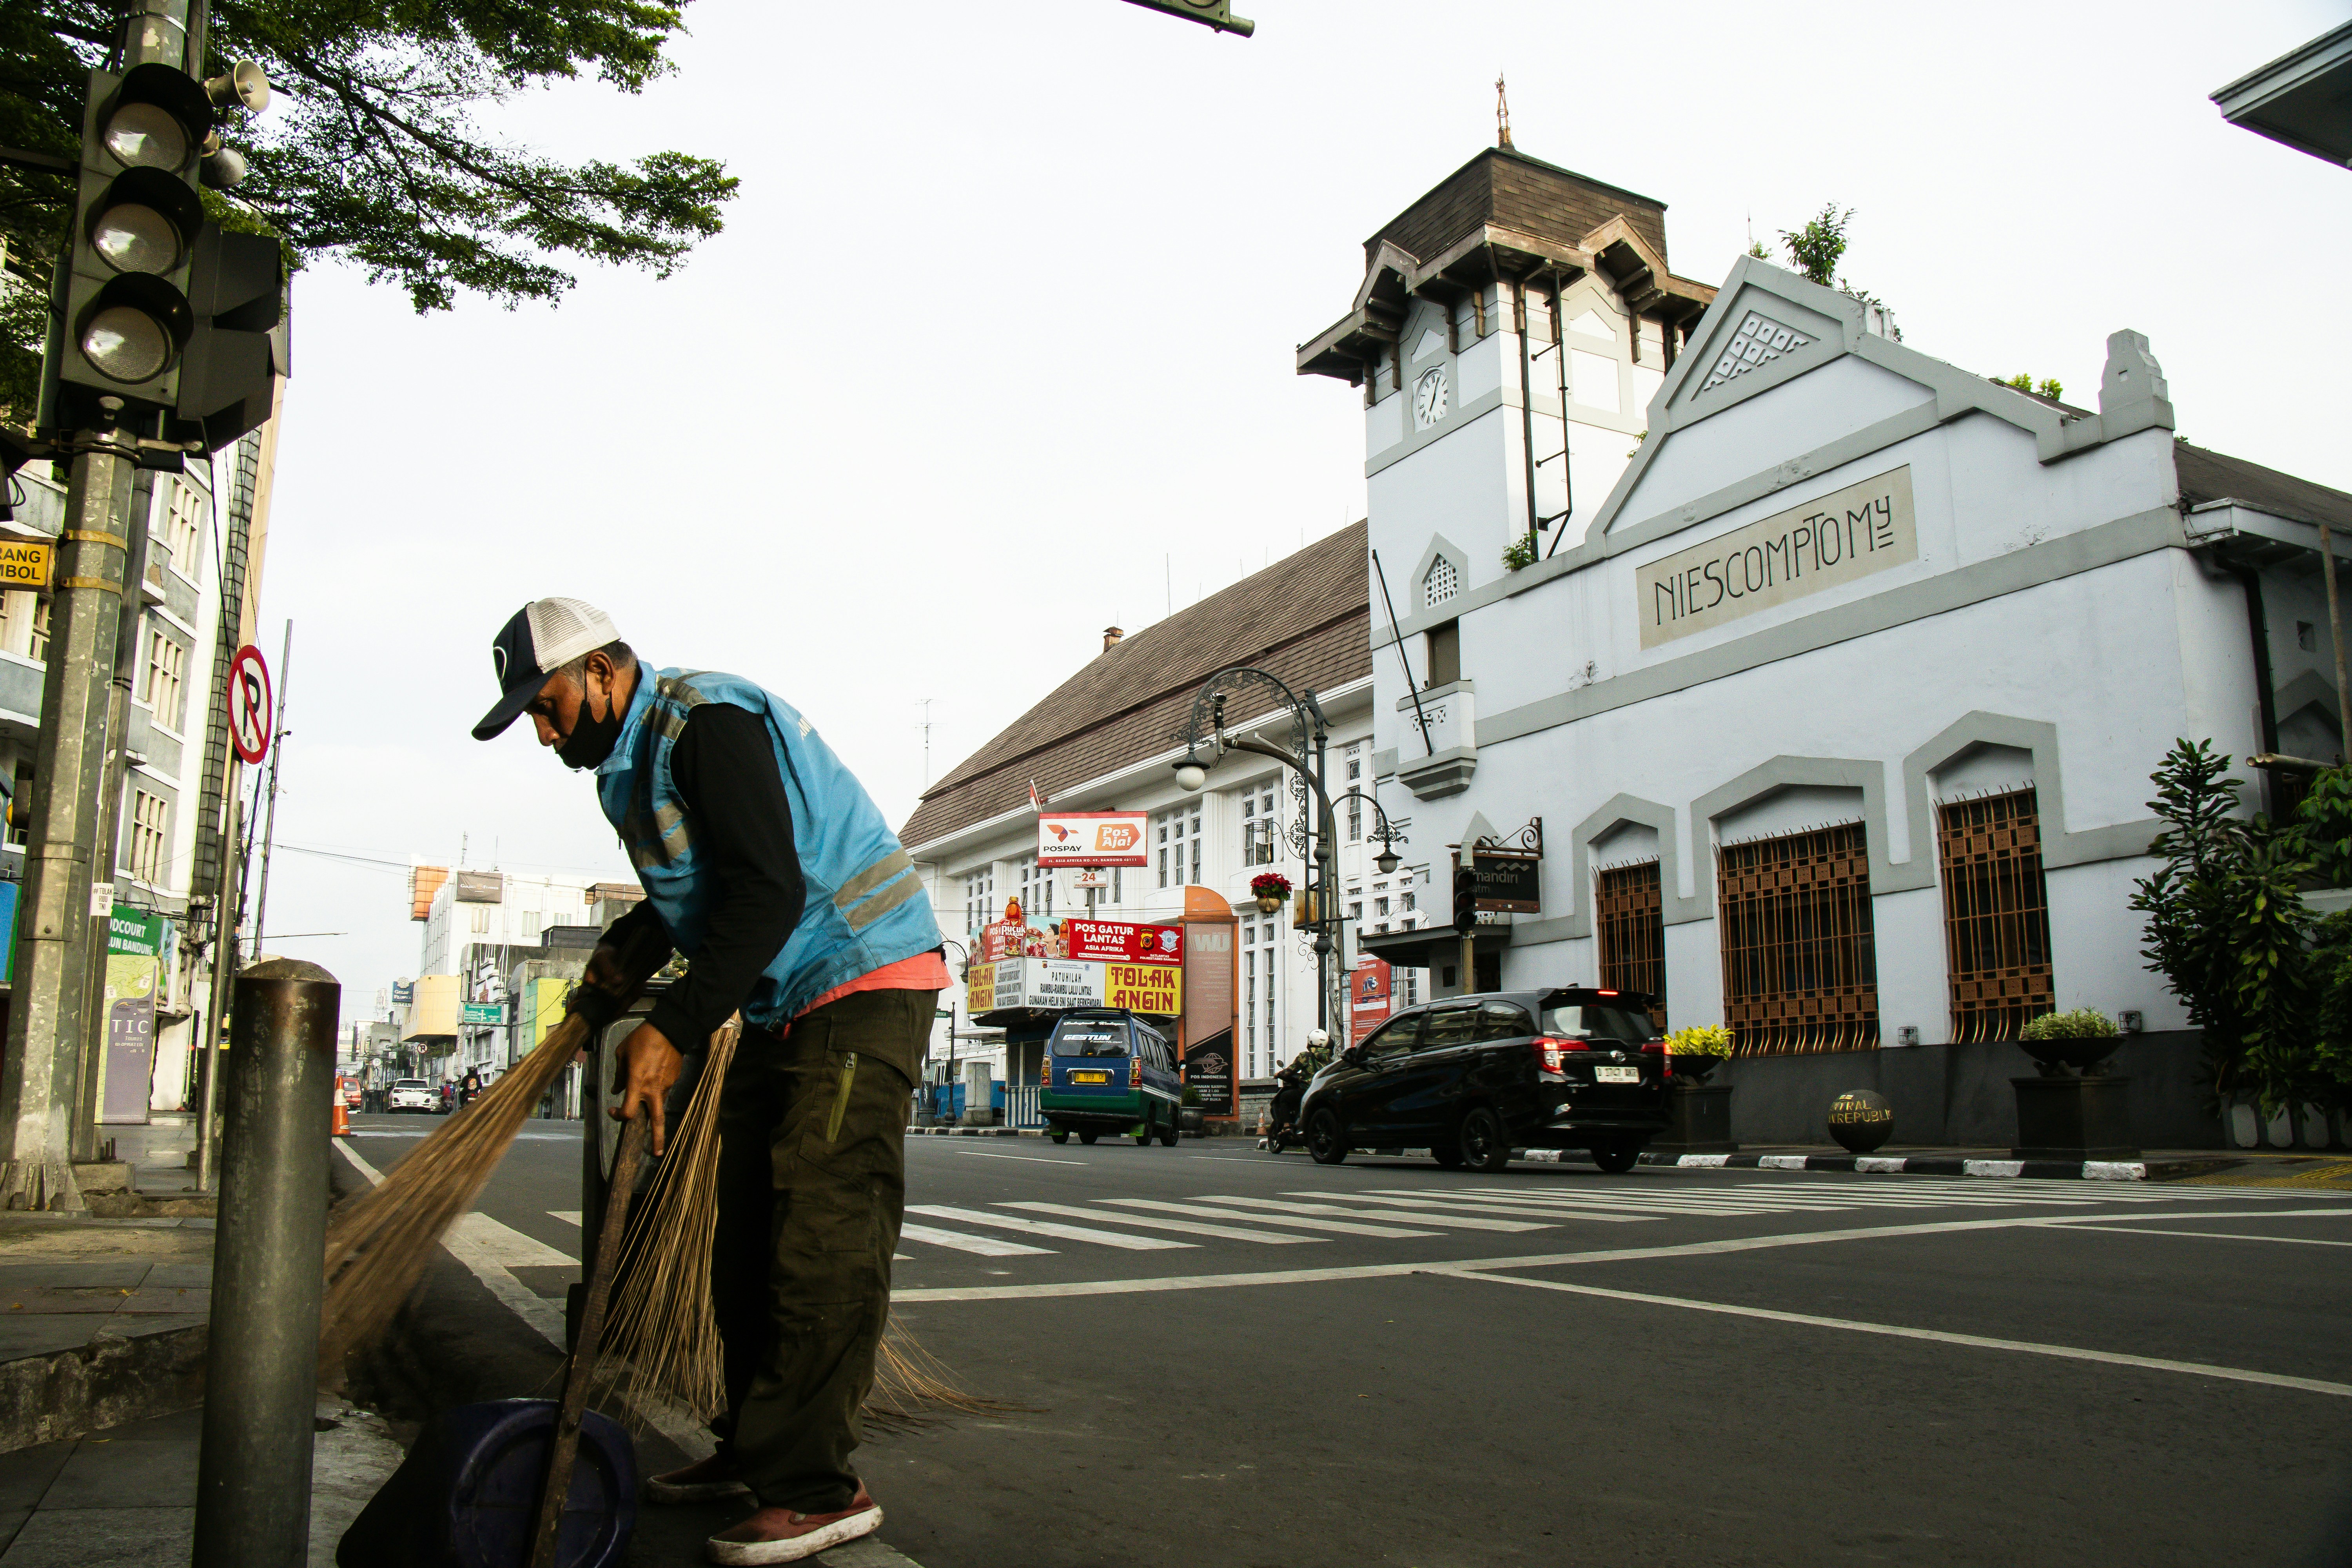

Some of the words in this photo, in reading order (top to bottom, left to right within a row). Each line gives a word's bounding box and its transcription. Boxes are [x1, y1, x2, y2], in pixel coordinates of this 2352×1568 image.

[0, 547, 41, 563] ANG
[1102, 827, 1129, 837] Pos
[1102, 836, 1131, 848] Aja!
[1082, 873, 1096, 882] 24
[1075, 923, 1096, 933] POS
[1098, 925, 1134, 935] GATUR
[1084, 933, 1125, 944] LANTAS
[108, 936, 122, 949] UN
[122, 939, 154, 956] BANDUNG
[969, 967, 994, 988] TOLAK
[1051, 972, 1082, 983] PATUHILAH
[1111, 966, 1176, 989] TOLAK
[1040, 984, 1067, 995] RAMBU-RAMBU
[1068, 985, 1078, 995] LALU
[1079, 986, 1092, 996] LINTAS
[970, 989, 993, 1009] ANGIN
[1029, 995, 1047, 1005] GUNAKAN
[1049, 996, 1058, 1006] HELM
[1067, 997, 1076, 1007] SAAT
[1077, 998, 1102, 1007] BERKENDARA
[1113, 989, 1174, 1011] ANGIN
[112, 1020, 149, 1034] TIC
